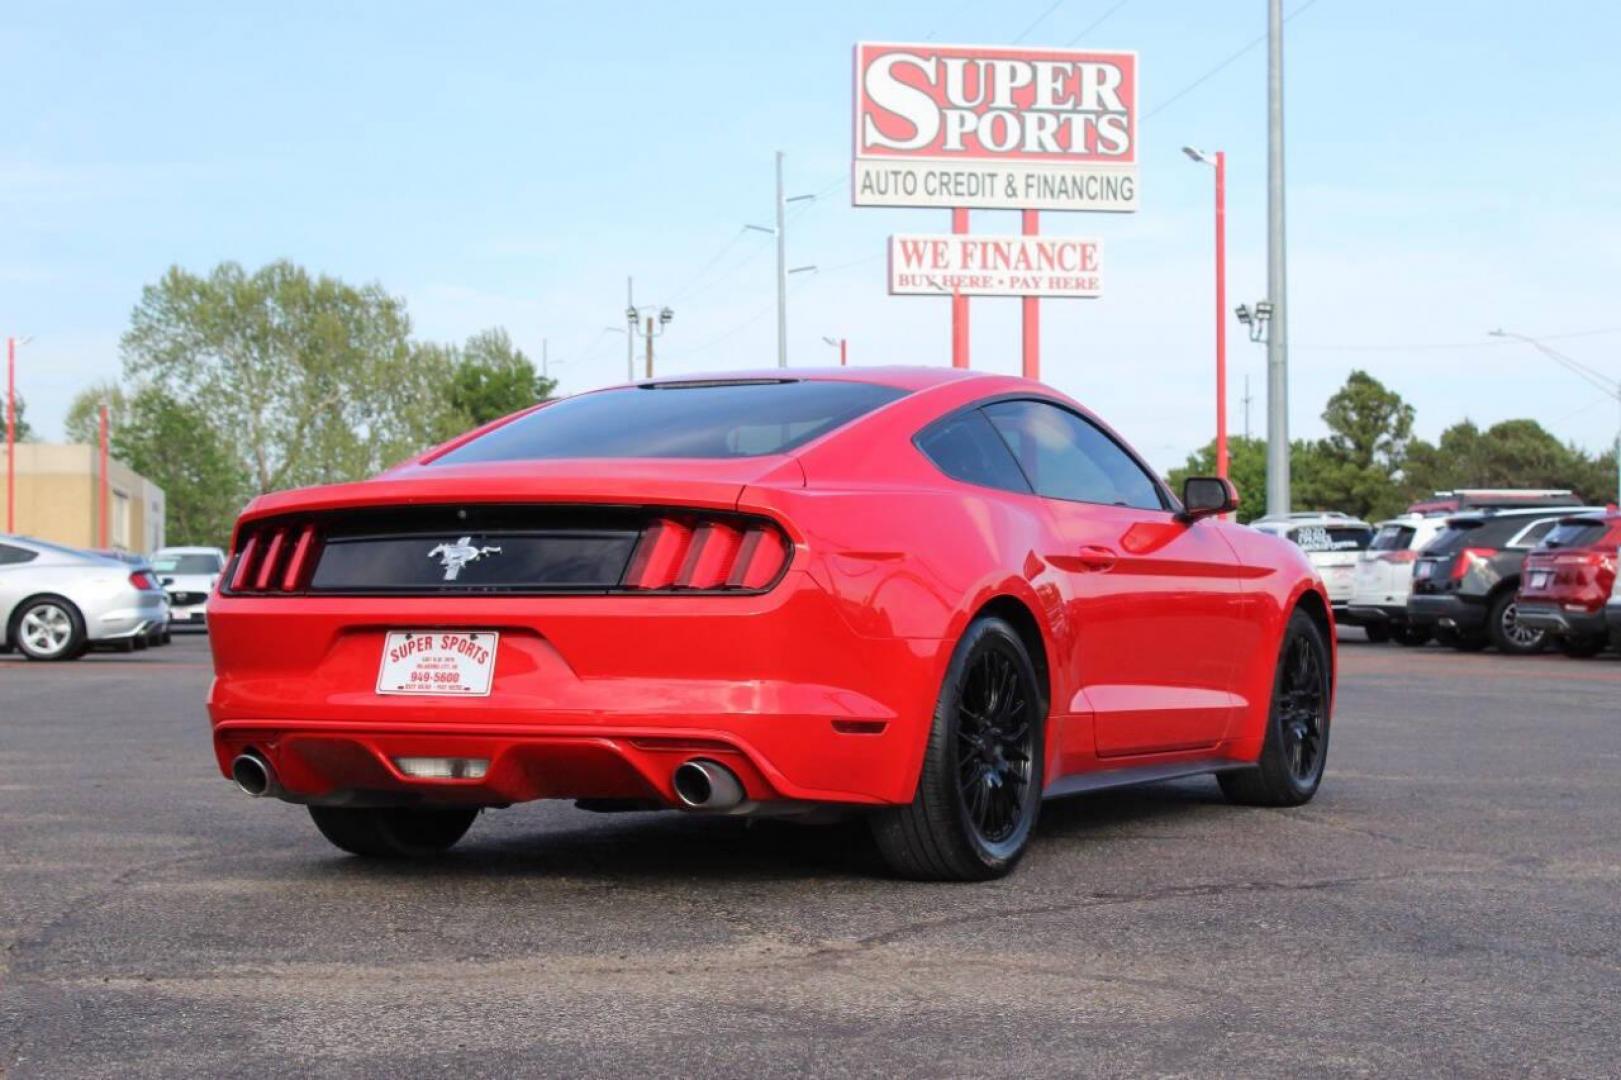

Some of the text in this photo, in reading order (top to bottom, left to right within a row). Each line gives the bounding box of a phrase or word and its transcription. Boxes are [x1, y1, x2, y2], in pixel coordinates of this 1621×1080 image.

[864, 52, 1127, 150] SUPER
[860, 170, 1134, 201] AUTO CREDIT & FINANCING
[900, 240, 1098, 272] WE FINANCE
[899, 273, 1100, 290] BUY HERE PAY HERE
[390, 635, 489, 664] SUPER SPORTS
